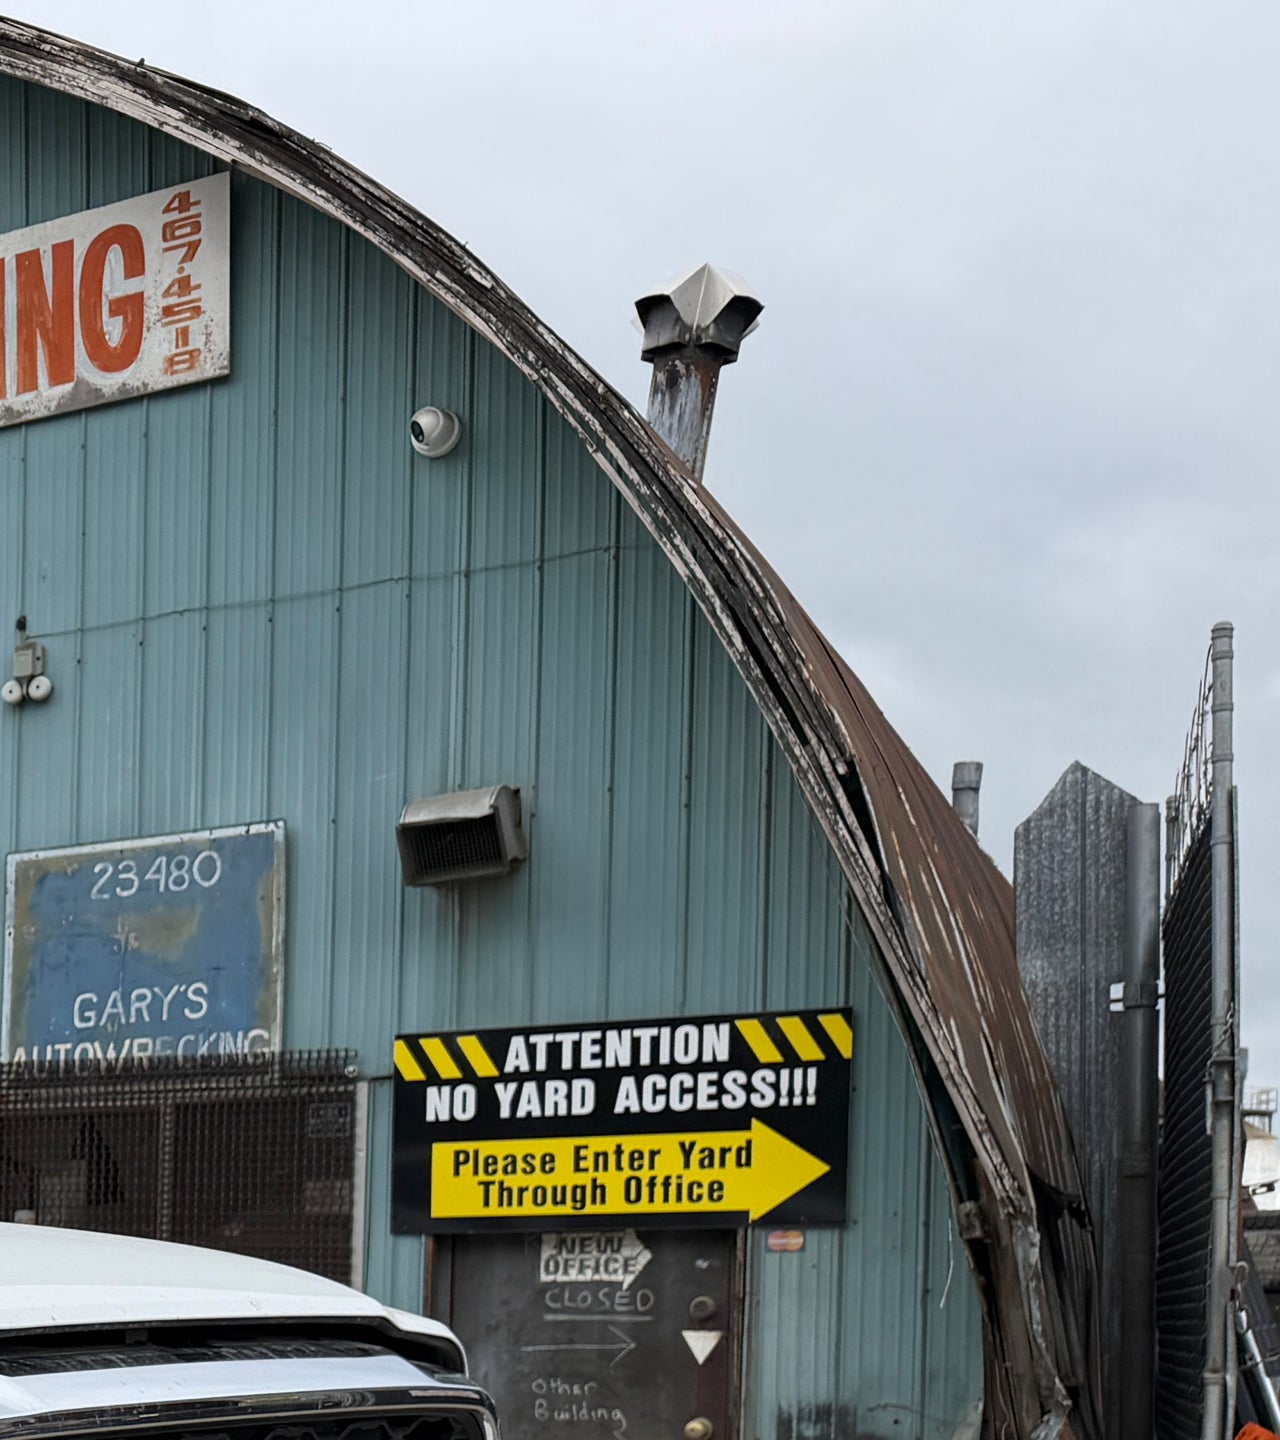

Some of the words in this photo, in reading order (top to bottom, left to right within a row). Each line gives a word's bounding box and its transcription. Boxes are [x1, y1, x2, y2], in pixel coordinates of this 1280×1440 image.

[90, 850, 222, 900] 23480
[73, 981, 209, 1029] GARY'S
[503, 1022, 731, 1075] ATTENTION
[425, 1083, 478, 1123] NO
[494, 1078, 596, 1119] YARD
[613, 1066, 818, 1115] ACCESS!!!
[452, 1148, 556, 1178] Please
[572, 1143, 662, 1174] Enter
[678, 1139, 753, 1170] Yard
[478, 1179, 607, 1211] Through
[623, 1175, 725, 1205] Office
[555, 1235, 624, 1255] NEW
[542, 1253, 638, 1277] OFFICE
[545, 1287, 655, 1312] CLOSED
[535, 1399, 627, 1432] Building
